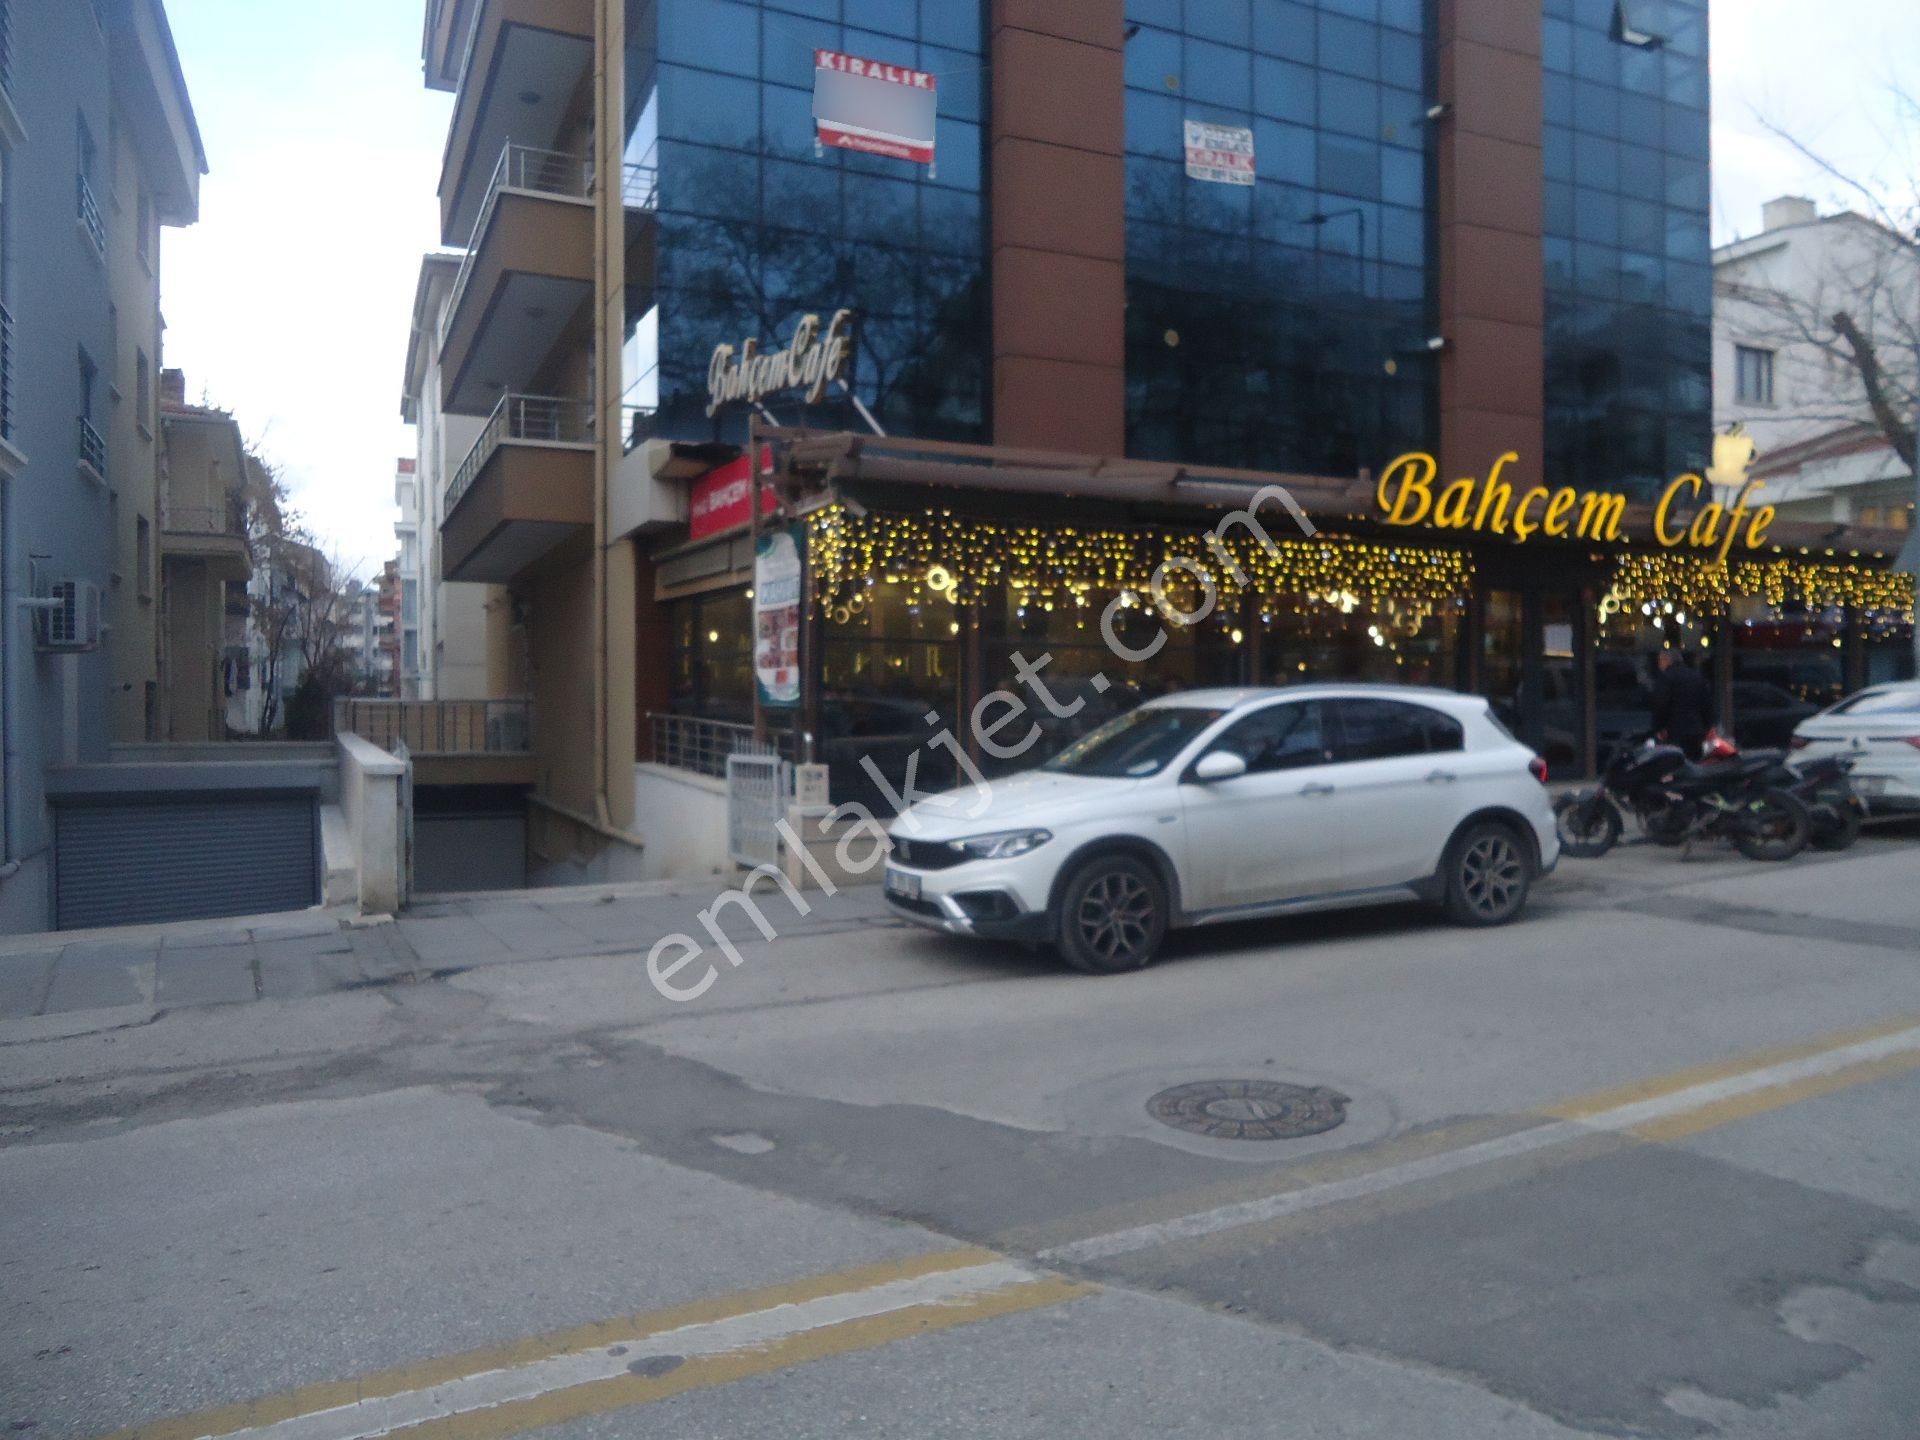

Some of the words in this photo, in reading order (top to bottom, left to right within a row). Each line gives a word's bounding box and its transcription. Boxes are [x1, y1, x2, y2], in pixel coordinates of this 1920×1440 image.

[818, 50, 929, 89] KIRALIK
[1376, 450, 1628, 544] Bahçem
[1654, 473, 1776, 572] Cafe
